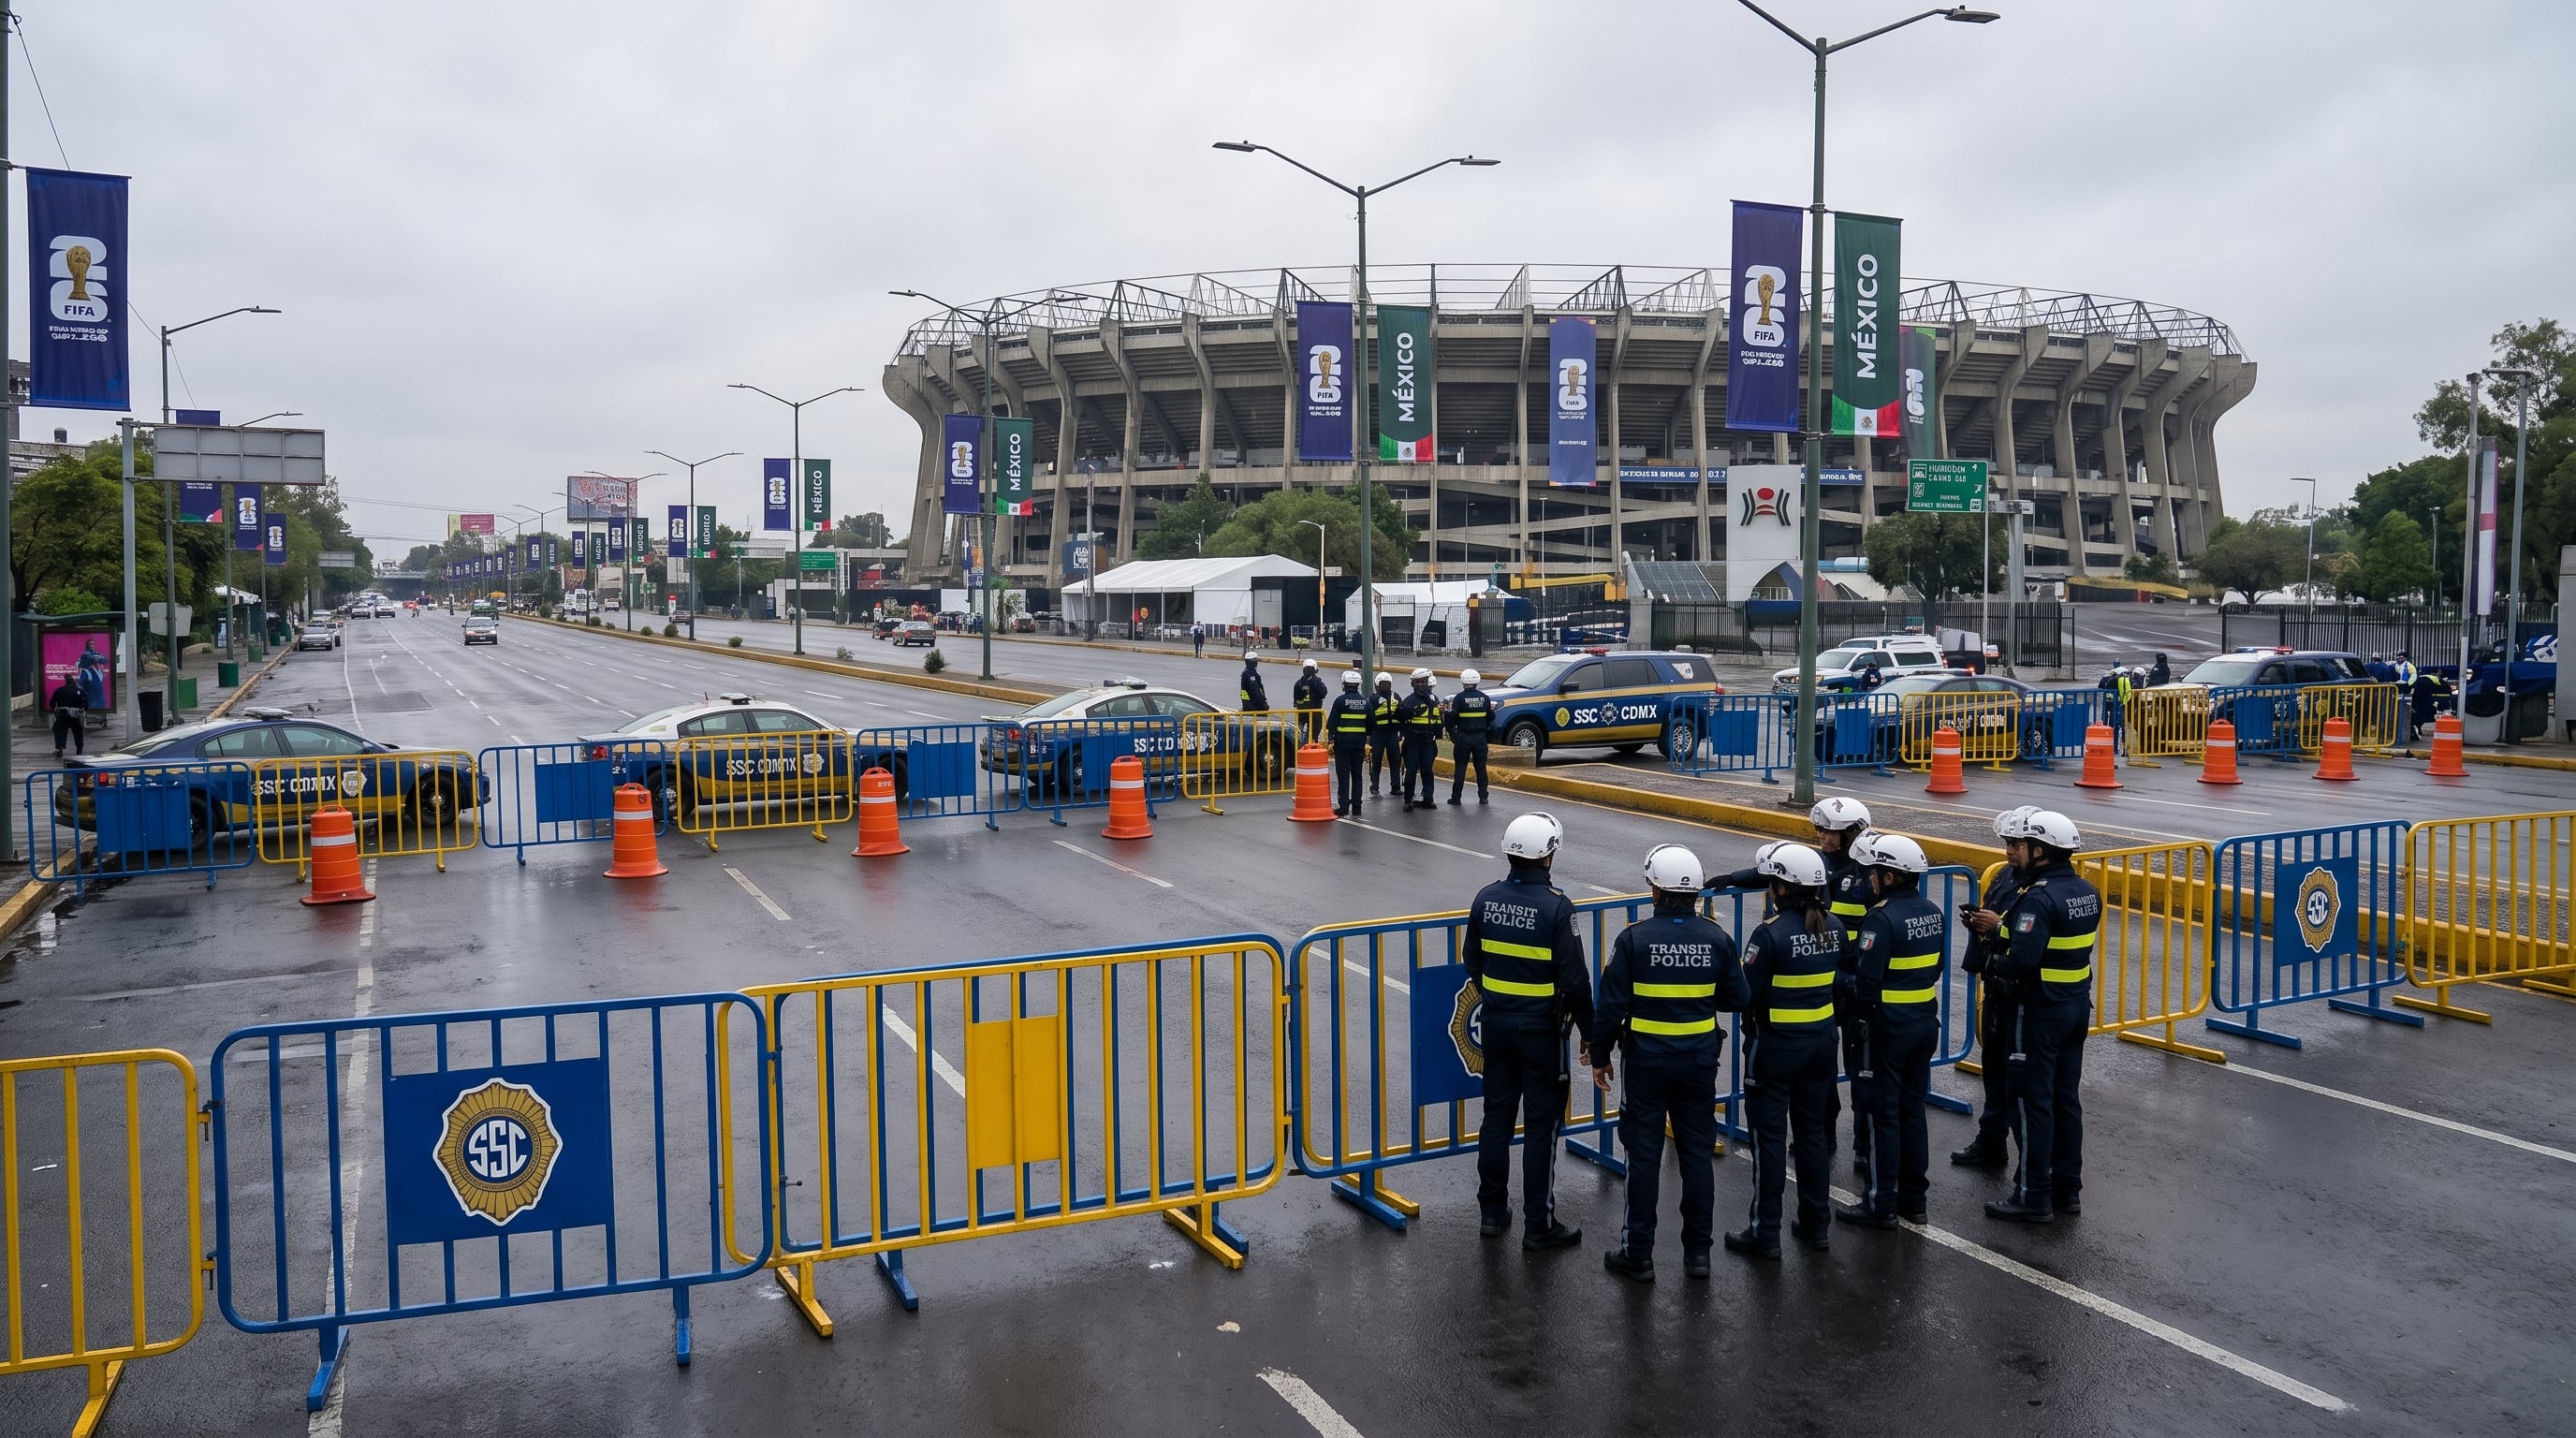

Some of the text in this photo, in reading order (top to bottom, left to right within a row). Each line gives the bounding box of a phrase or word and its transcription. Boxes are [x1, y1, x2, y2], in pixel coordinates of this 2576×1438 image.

[64, 304, 95, 316] FIFA
[1851, 254, 1878, 379] MÉXICO
[1754, 330, 1776, 342] FIFA
[1392, 332, 1414, 422] MÉXICO
[1006, 433, 1021, 491] MÉXICO
[1573, 705, 1658, 724] SSC CDMX
[1484, 901, 1537, 917] TRANSIT
[2306, 890, 2328, 925] SSC
[1483, 911, 1535, 930] POLICE
[1908, 922, 1943, 940] POLICE
[1649, 944, 1712, 955] TRANSIT
[1649, 955, 1711, 967] POLICE
[468, 1120, 527, 1178] SSC
